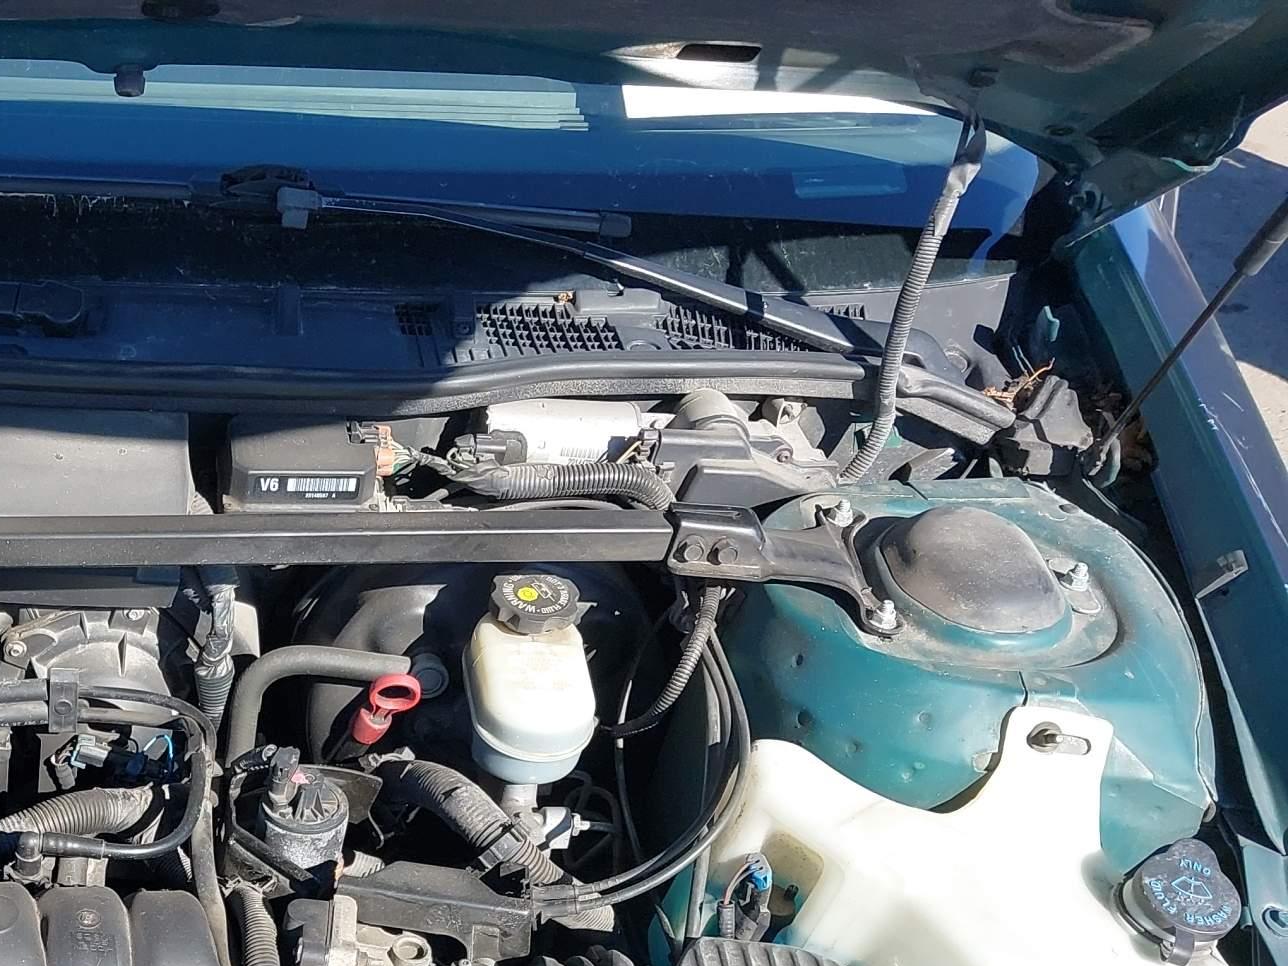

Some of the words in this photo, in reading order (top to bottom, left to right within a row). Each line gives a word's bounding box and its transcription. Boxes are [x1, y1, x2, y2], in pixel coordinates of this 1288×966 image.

[260, 477, 280, 492] V6
[502, 582, 536, 613] WARNING
[1178, 858, 1212, 876] ONLY
[1149, 879, 1178, 914] FLUID
[1183, 901, 1232, 926] WASHER
